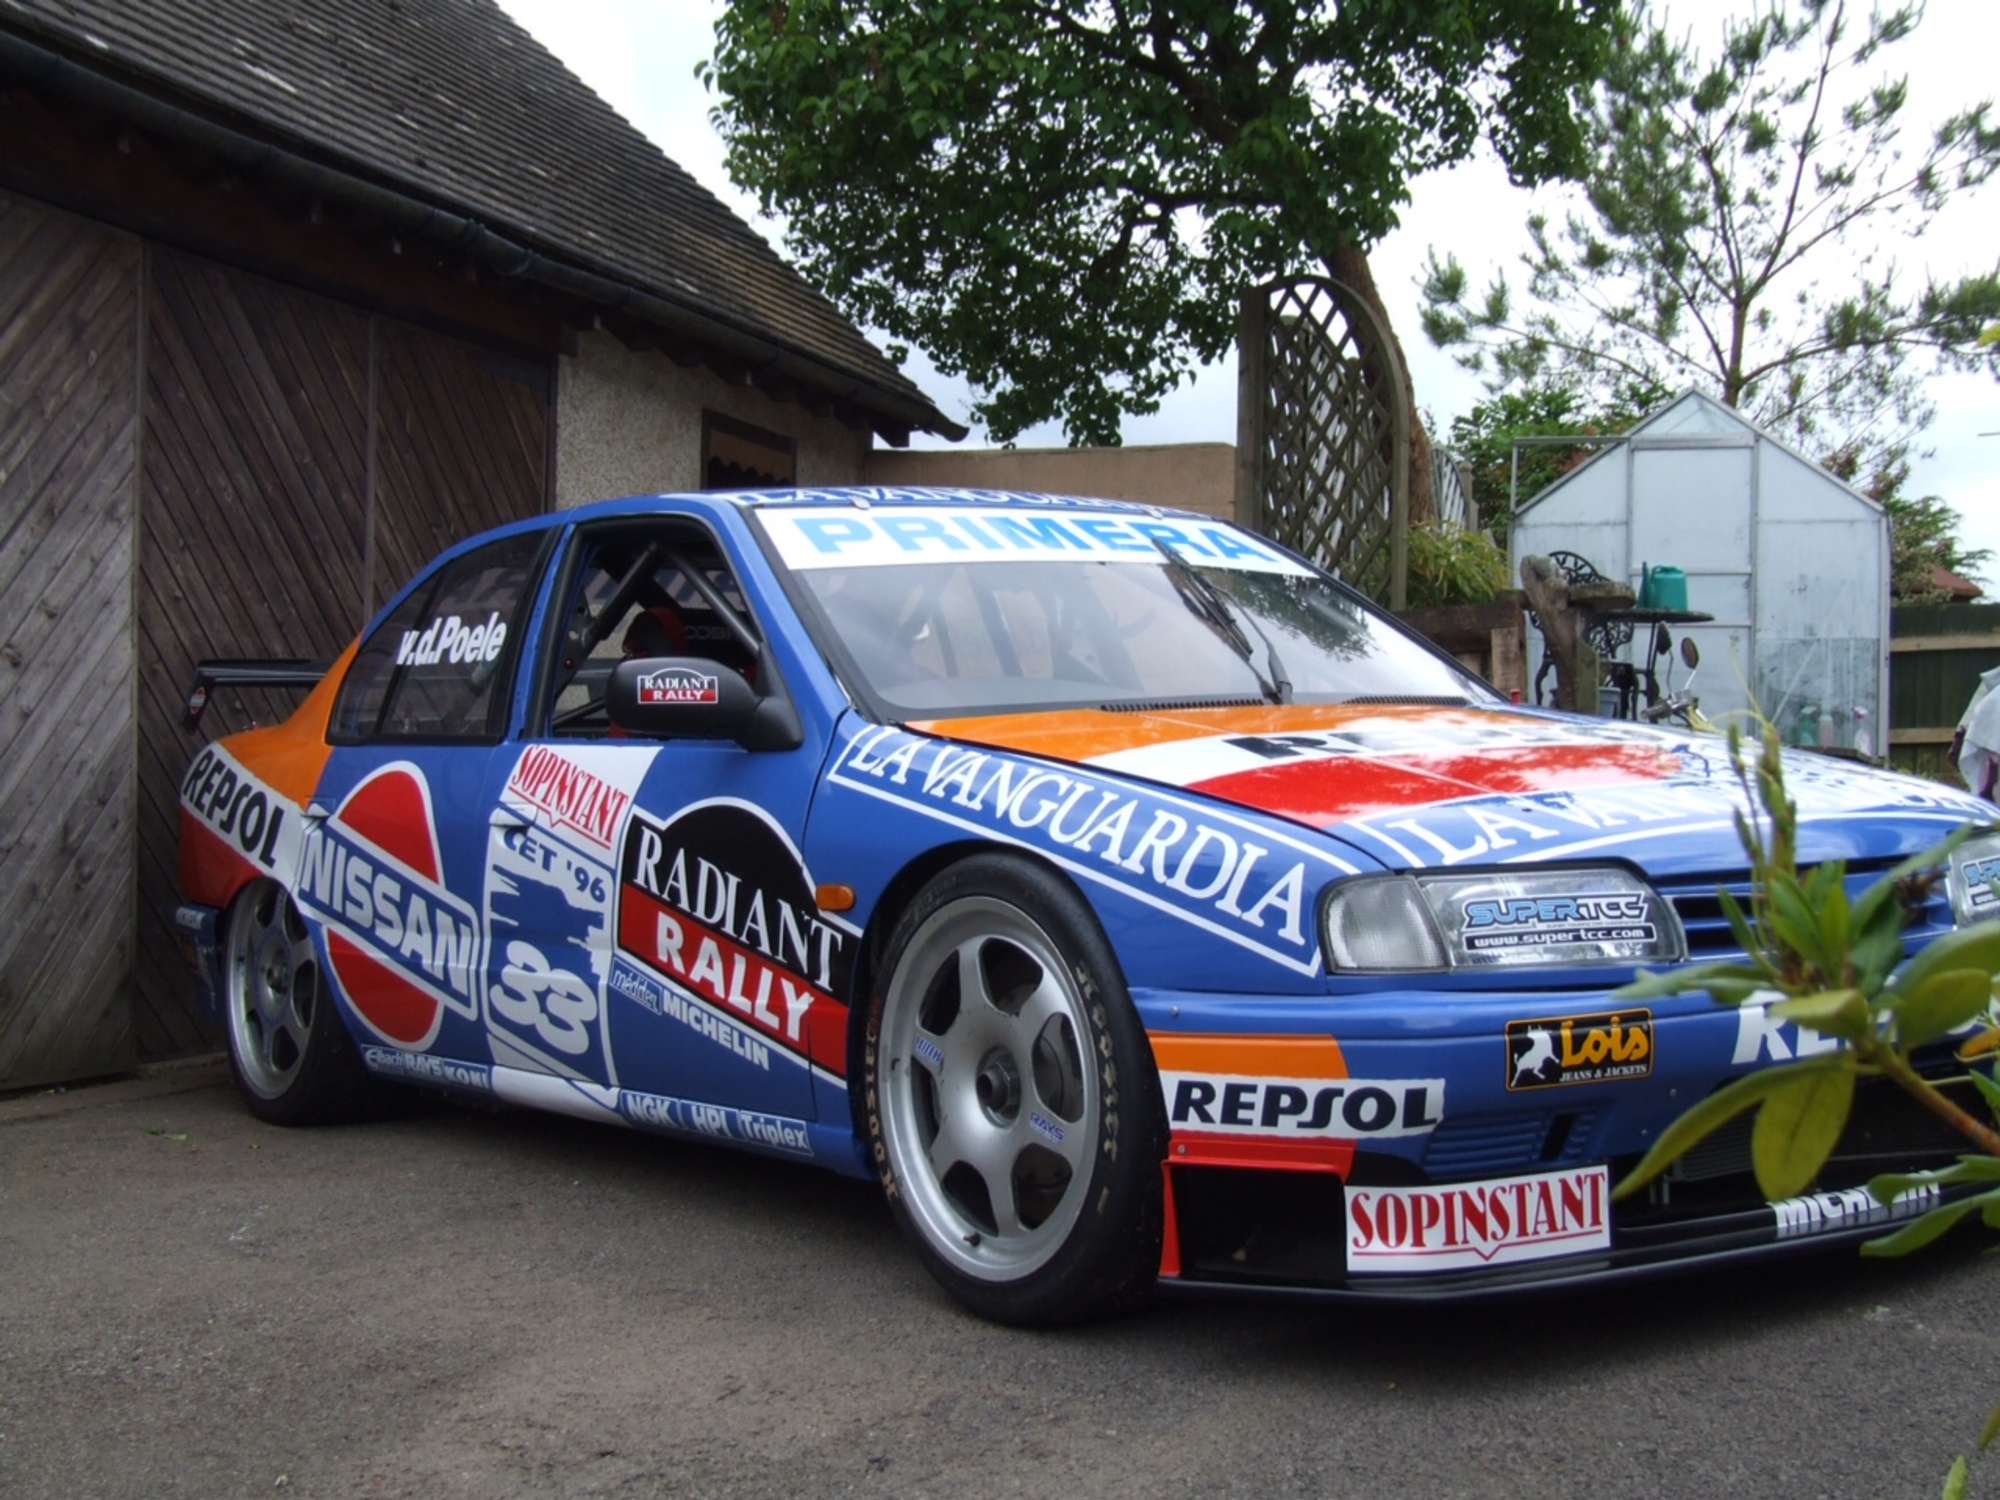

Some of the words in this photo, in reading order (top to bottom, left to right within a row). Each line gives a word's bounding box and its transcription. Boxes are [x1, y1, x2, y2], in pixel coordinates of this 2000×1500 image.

[793, 516, 1280, 563] PRIMERA
[396, 611, 507, 666] v.d.Poele
[645, 677, 711, 689] RADIANT
[653, 689, 704, 700] RALLY
[183, 749, 285, 869] REPSOL
[512, 744, 629, 843] SOPINSTANT
[847, 727, 919, 784] LA
[921, 739, 1307, 946] VANGUARDIA
[1387, 803, 1560, 864] LA
[503, 826, 557, 872] CET
[566, 860, 606, 903] '96
[302, 827, 471, 1001] NISSAN
[634, 826, 842, 991] RADIANT
[1467, 896, 1643, 925] SUPERTCC
[1474, 929, 1645, 948] www.supertcc.com
[490, 940, 597, 1055] 33
[656, 911, 814, 1042] RALLY
[663, 989, 770, 1071] MICHELIN
[1561, 1016, 1649, 1068] Lois
[445, 1064, 490, 1089] KONI
[1560, 1069, 1592, 1082] JEANS
[1594, 1068, 1602, 1079] &
[1603, 1064, 1648, 1077] JACKETS
[627, 1093, 674, 1124] NGK
[742, 1113, 807, 1149] Triplex
[1172, 1080, 1439, 1131] REPSOL
[1351, 1172, 1606, 1249] SOPINSTANT
